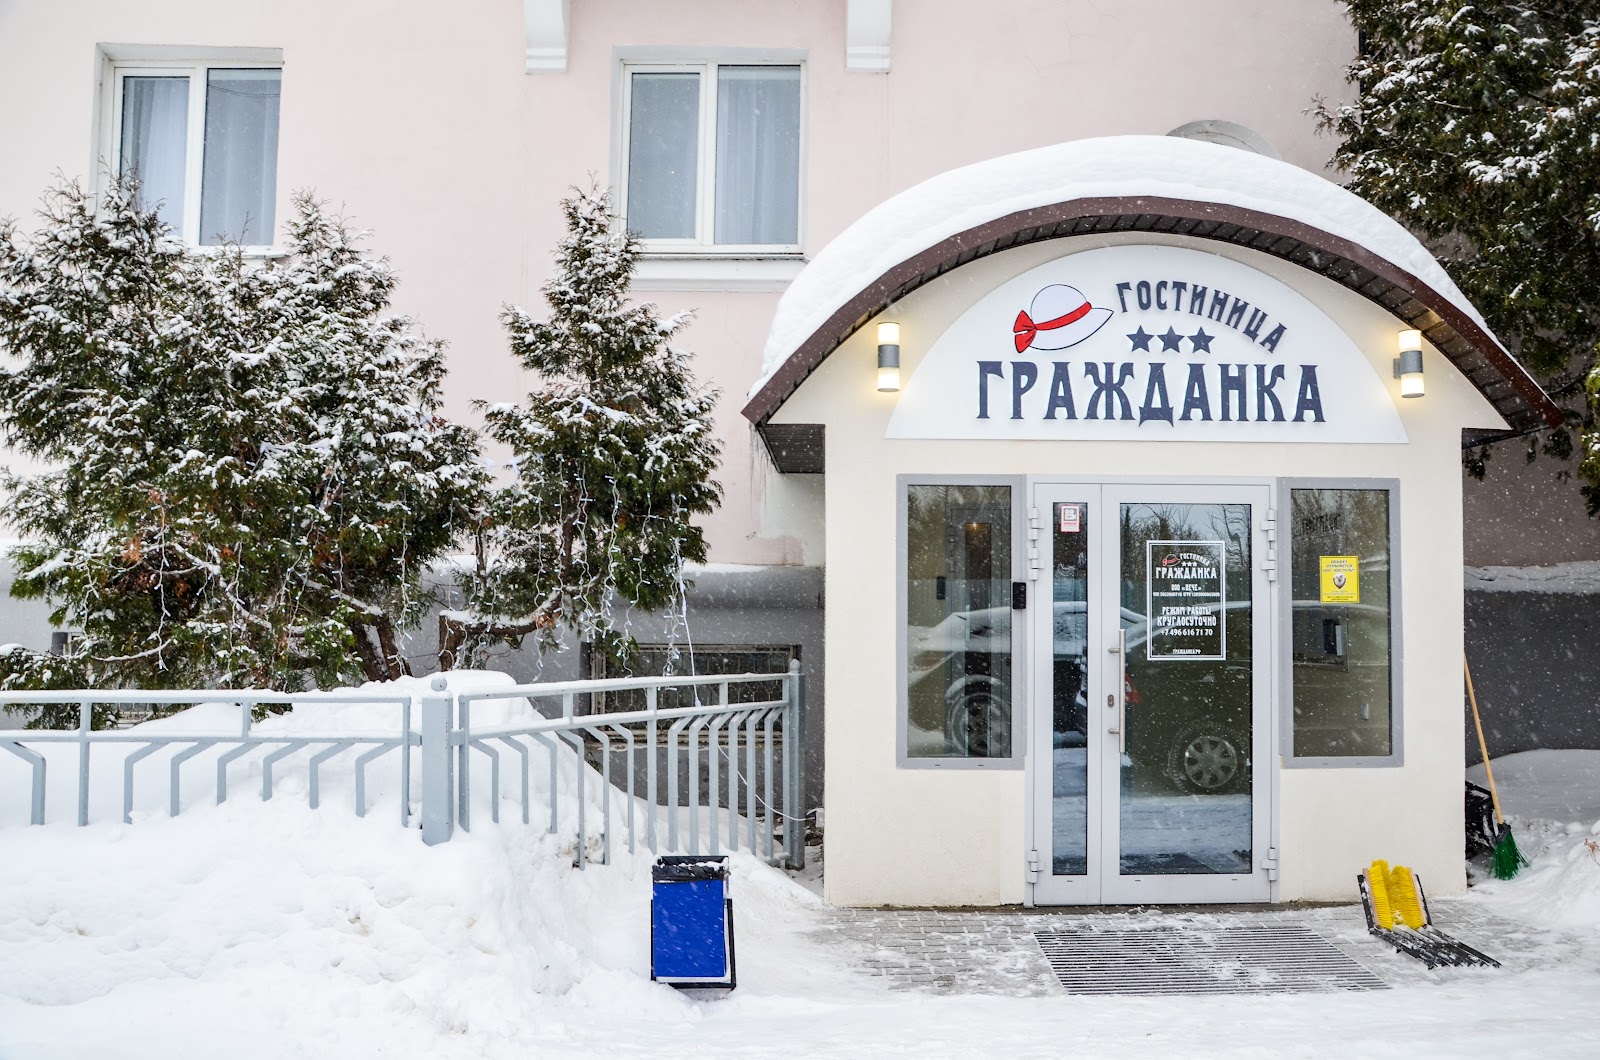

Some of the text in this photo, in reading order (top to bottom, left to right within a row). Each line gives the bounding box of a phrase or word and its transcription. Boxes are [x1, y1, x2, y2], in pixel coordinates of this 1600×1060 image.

[1115, 280, 1288, 354] ГОСТИНИЦА
[976, 360, 1326, 428] ГРАЖДАНКА
[1155, 567, 1217, 579] ГРАЖДАНКА
[1162, 607, 1212, 615] РЕЖИМ РАБОТЫ
[1157, 616, 1217, 626] КРУГЛОСУТОЧНО
